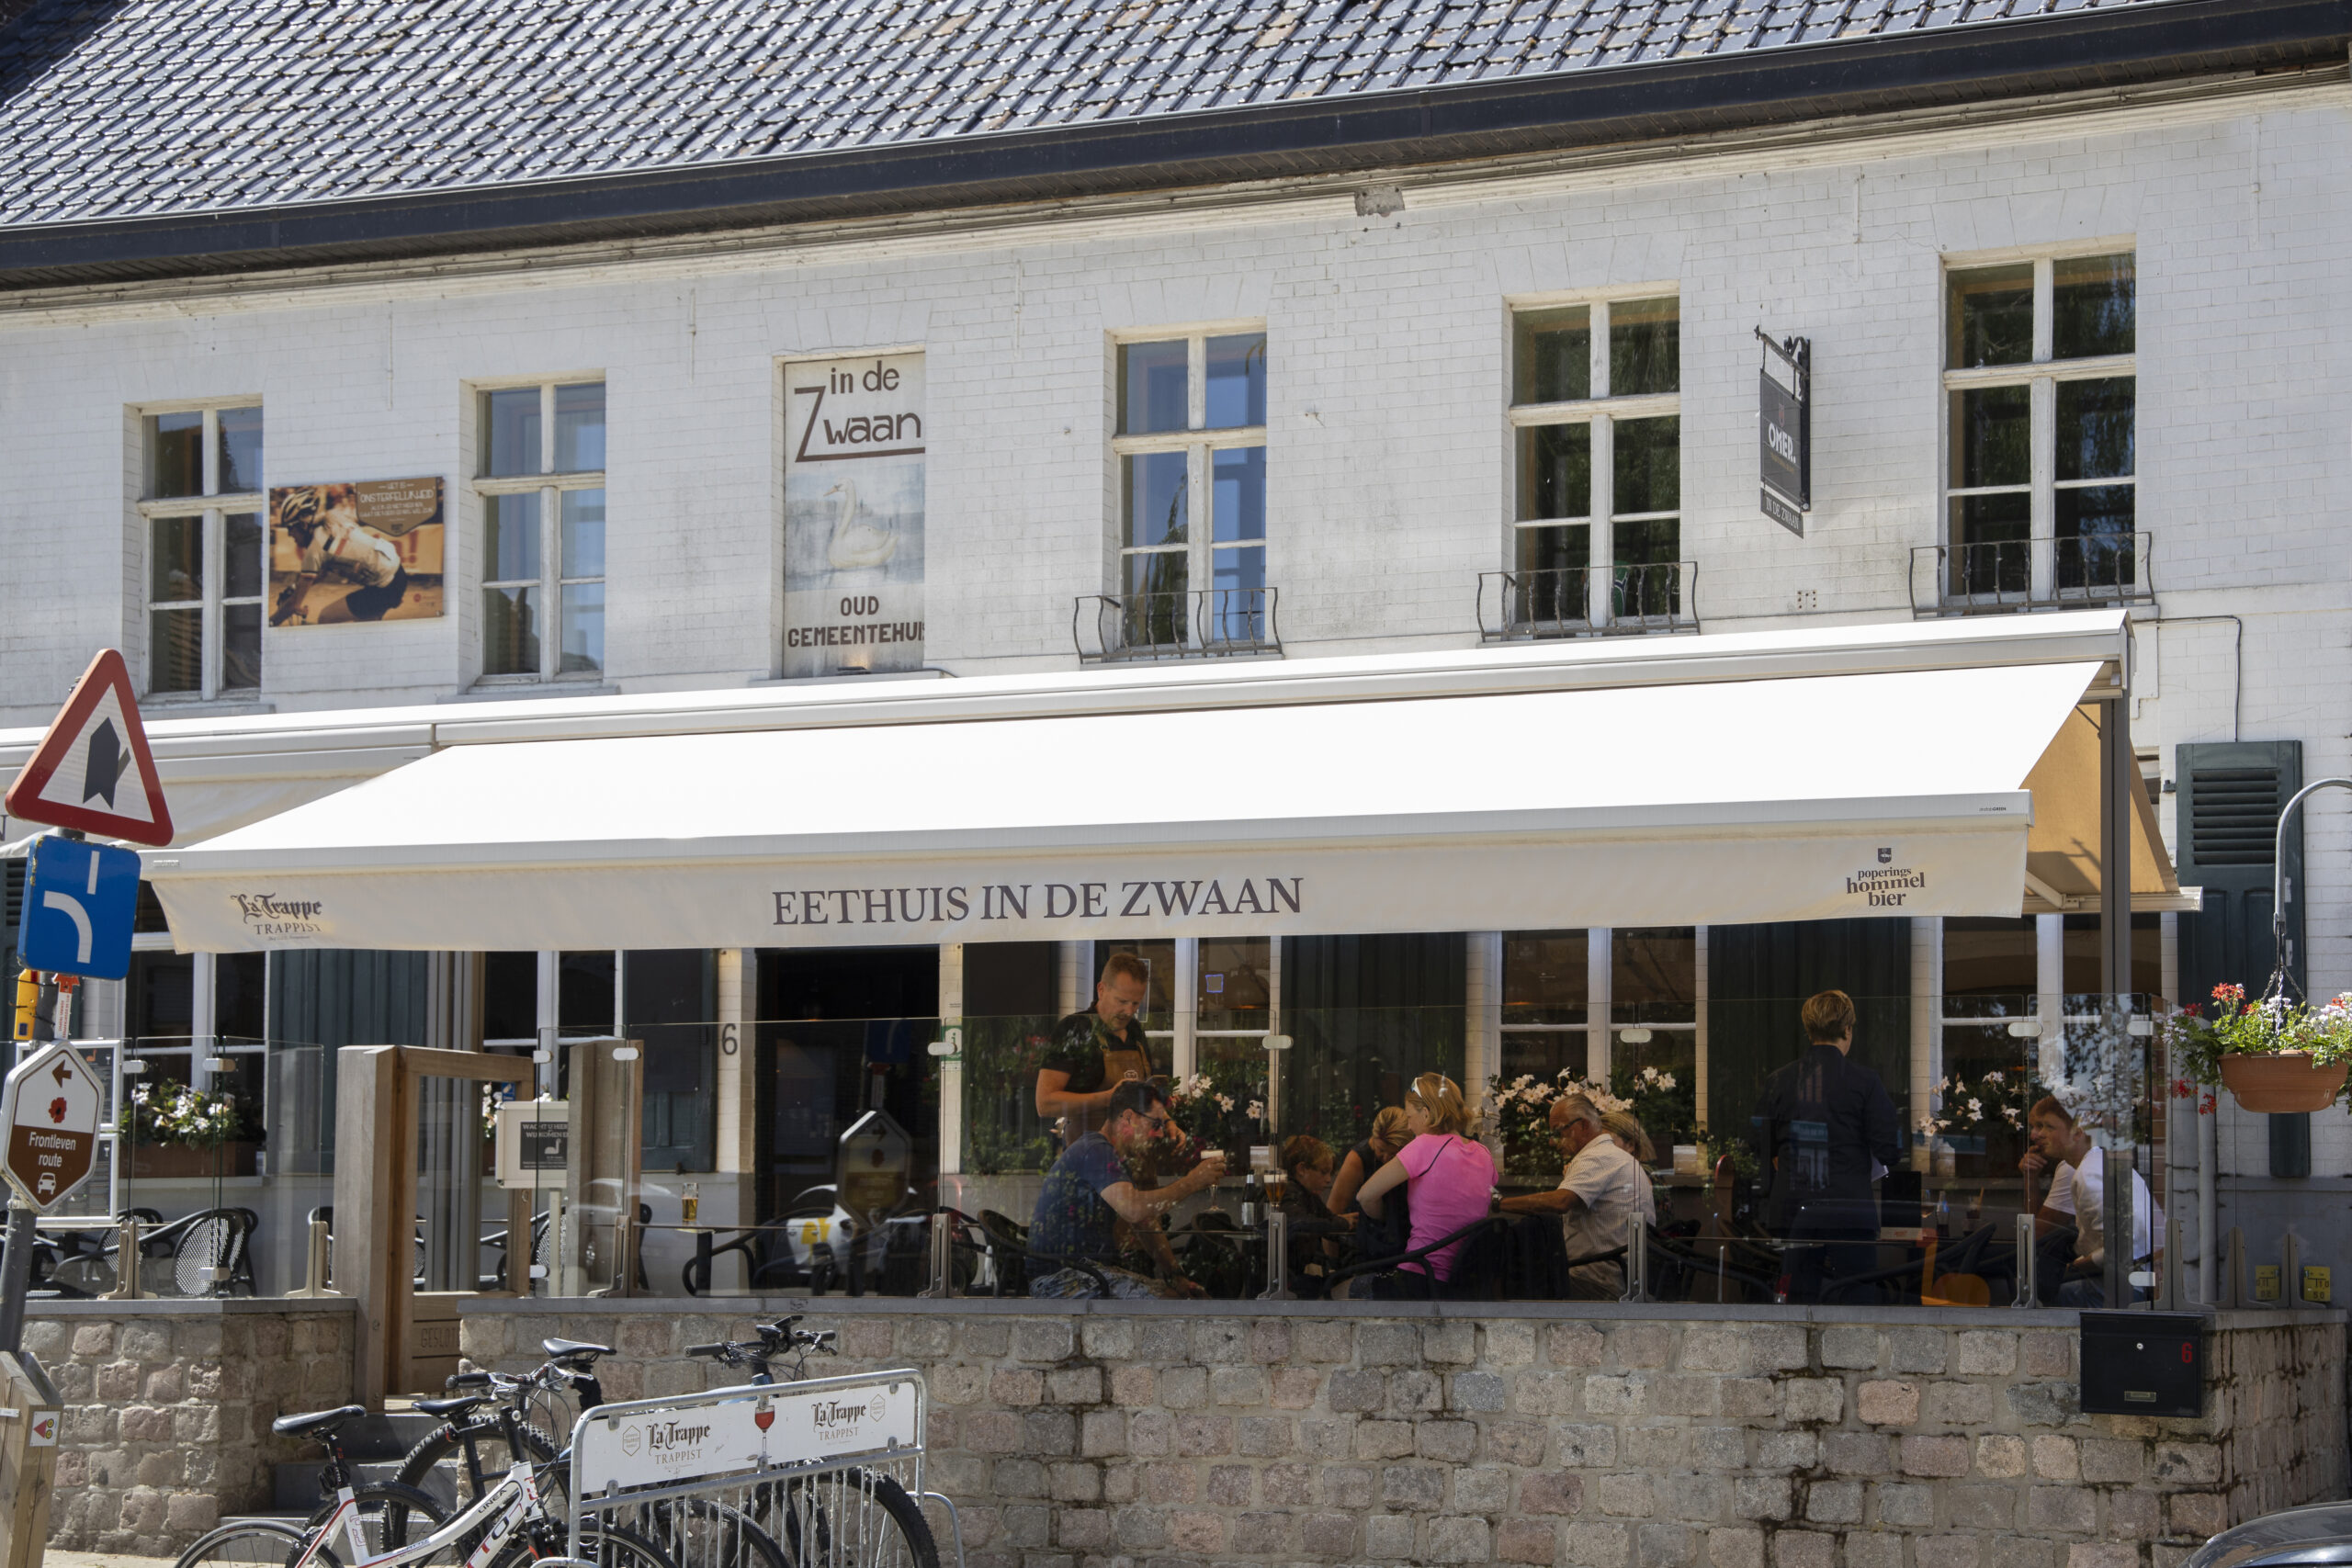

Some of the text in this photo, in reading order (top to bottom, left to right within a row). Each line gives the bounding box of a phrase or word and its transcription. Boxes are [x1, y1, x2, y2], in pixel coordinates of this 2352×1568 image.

[831, 360, 899, 394] in de
[794, 386, 925, 463] Zwaan
[1772, 501, 1781, 519] DE
[1781, 506, 1799, 530] ZWAAN
[840, 596, 879, 616] OUD
[787, 621, 924, 648] GEMEENTEHUI
[1847, 872, 1926, 894] hommel
[1858, 867, 1912, 881] poperings
[254, 892, 322, 920] Trappe
[772, 877, 1305, 925] EETHUIS IN DE ZWAAN
[1868, 890, 1906, 907] bier
[722, 1022, 738, 1055] 6
[28, 1132, 76, 1151] Frontleven
[38, 1153, 62, 1168] route
[421, 1326, 459, 1348] GESLOT
[2181, 1342, 2193, 1363] 6
[664, 1420, 710, 1450] Trappe
[820, 1427, 859, 1440] TRAPPIST
[655, 1449, 703, 1464] TRAPPIST
[478, 1489, 507, 1514] LINEA
